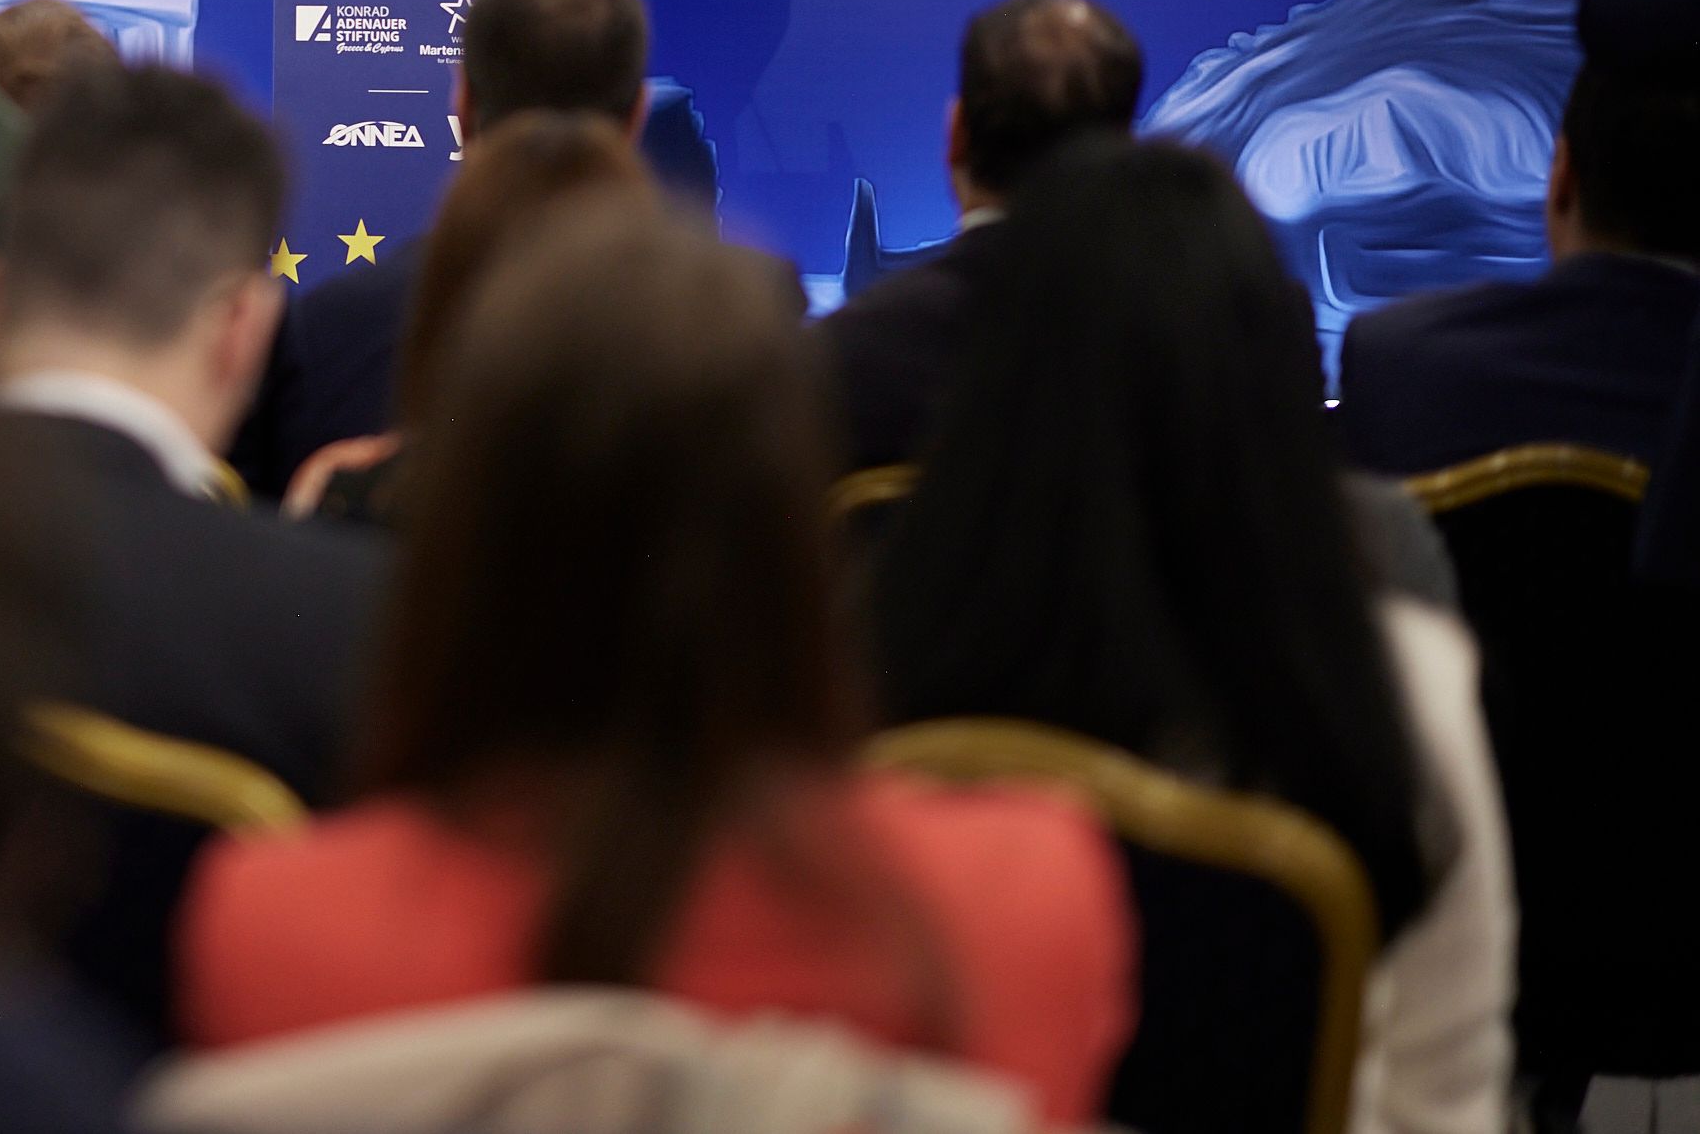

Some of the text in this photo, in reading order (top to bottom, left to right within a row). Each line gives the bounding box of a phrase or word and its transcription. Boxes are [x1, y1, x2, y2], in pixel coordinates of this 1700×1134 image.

[336, 5, 389, 17] KONRAD
[336, 18, 407, 30] ADENAUER
[336, 30, 400, 42] STIFTUNG
[336, 43, 404, 54] Greece & Cyprus
